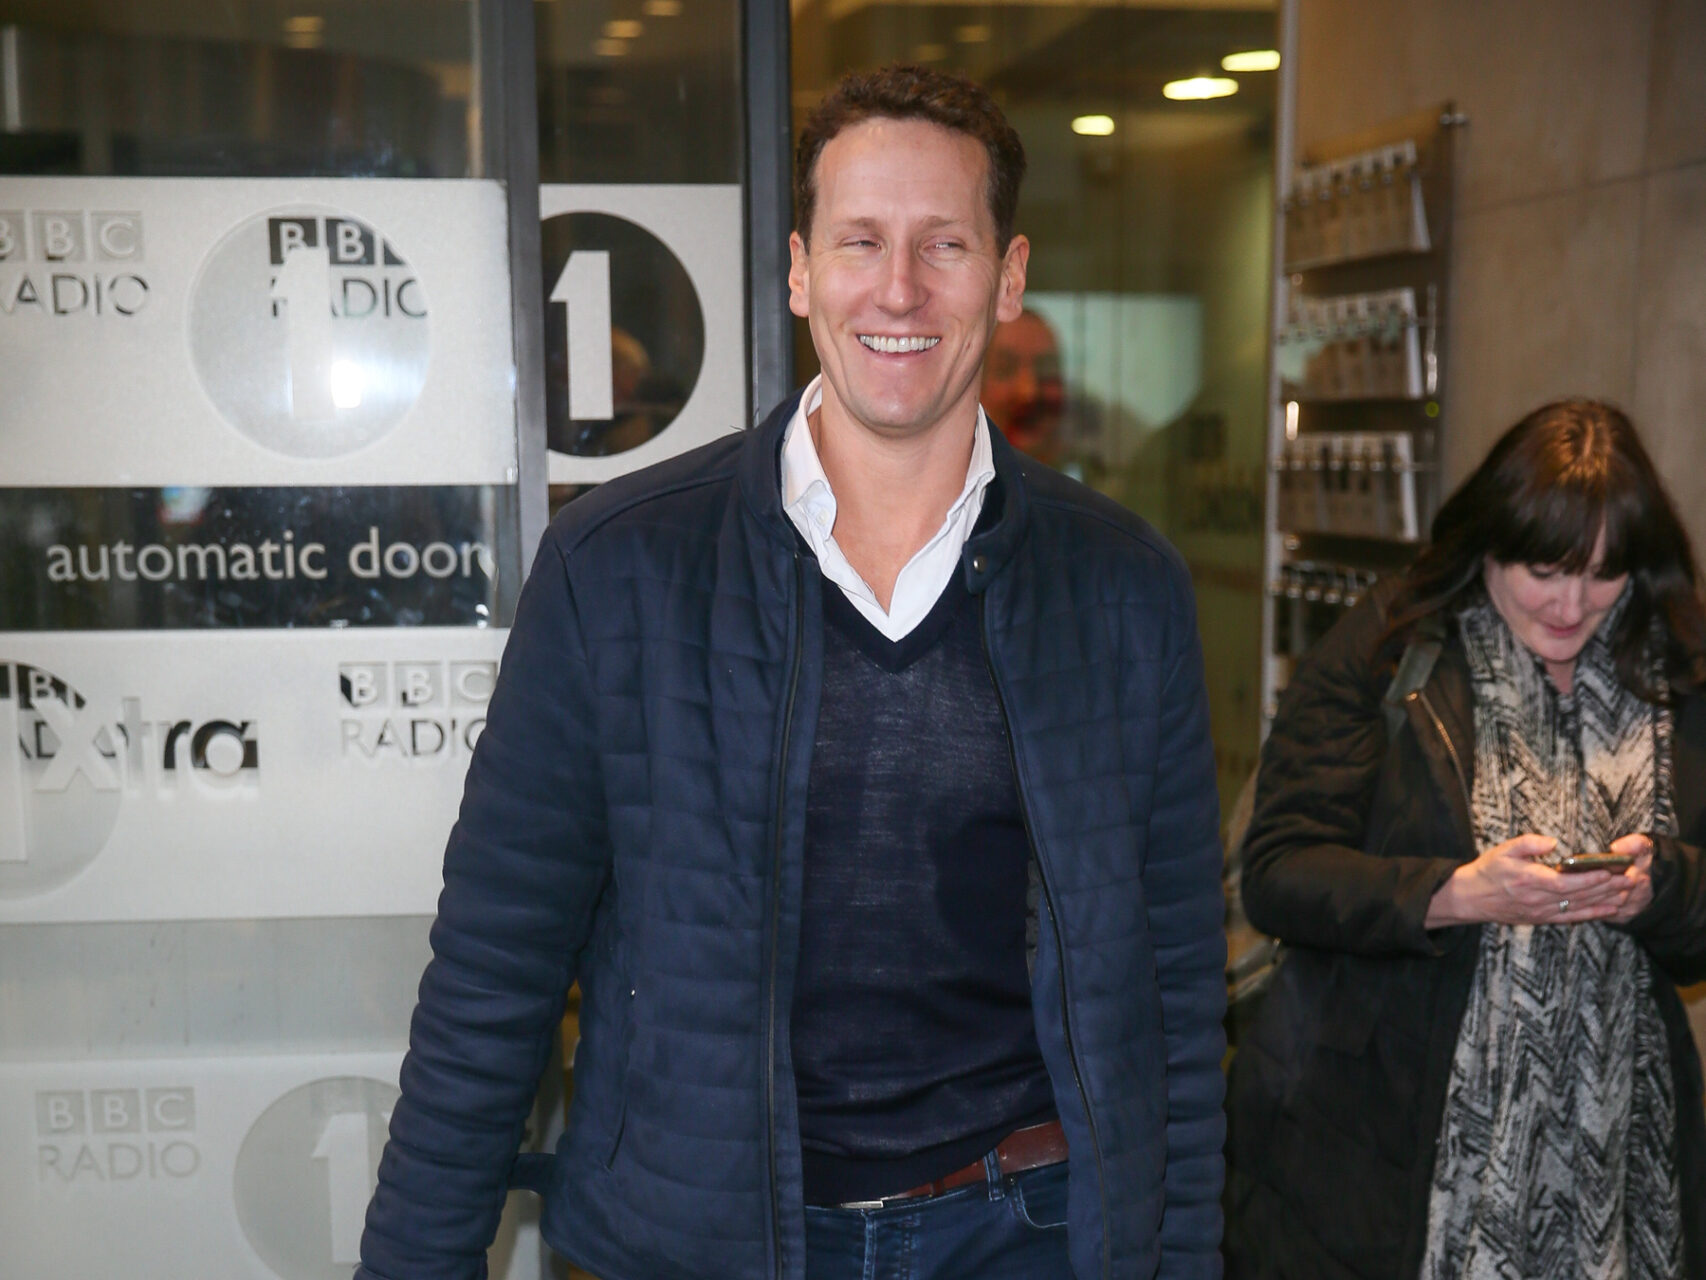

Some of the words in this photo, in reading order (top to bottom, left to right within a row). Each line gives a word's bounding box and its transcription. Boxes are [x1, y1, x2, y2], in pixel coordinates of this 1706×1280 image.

[549, 250, 614, 421] 1
[46, 531, 328, 582] automatic
[339, 661, 498, 708] BBC
[36, 1084, 196, 1136] BBC
[37, 1140, 201, 1182] RADIO
[310, 1112, 369, 1264] 1
